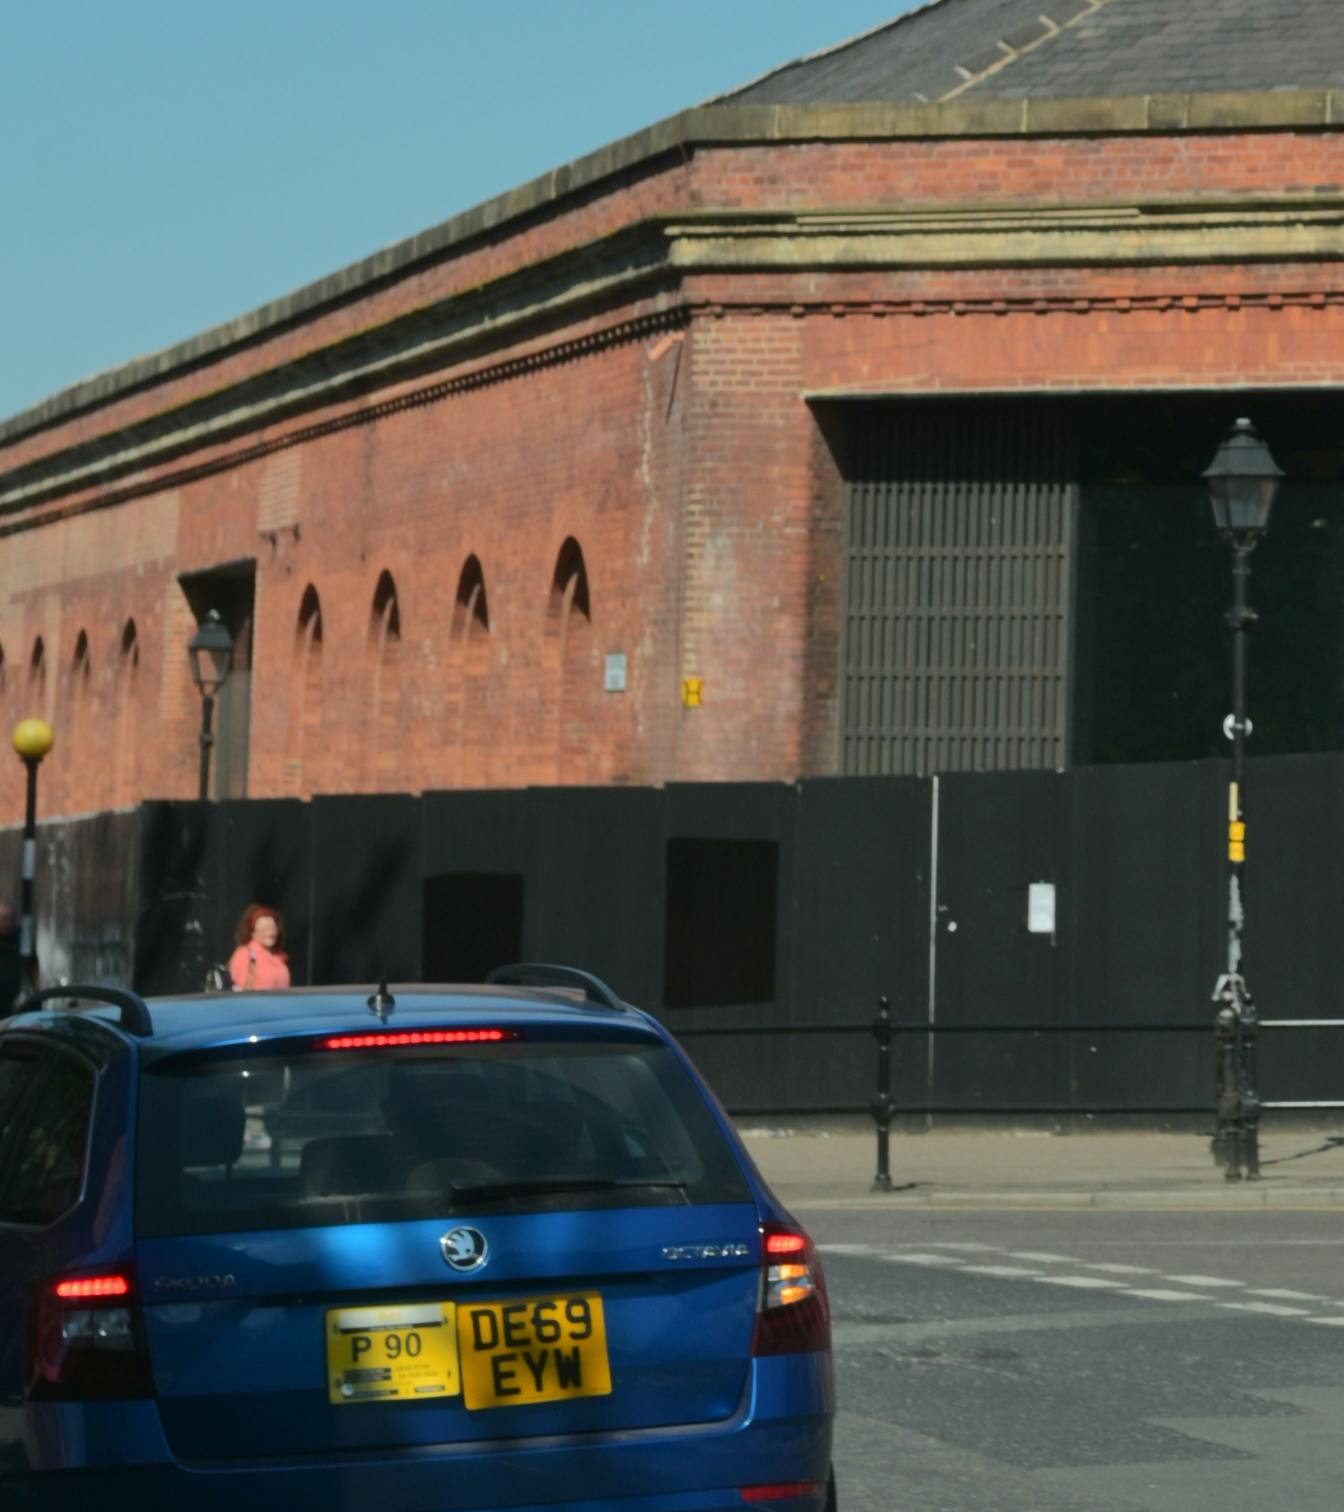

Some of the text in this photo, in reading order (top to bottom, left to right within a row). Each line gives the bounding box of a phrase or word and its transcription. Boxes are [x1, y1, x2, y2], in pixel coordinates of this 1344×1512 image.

[351, 1332, 421, 1363] P 90
[470, 1298, 592, 1351] DE69
[491, 1345, 582, 1397] EYW
